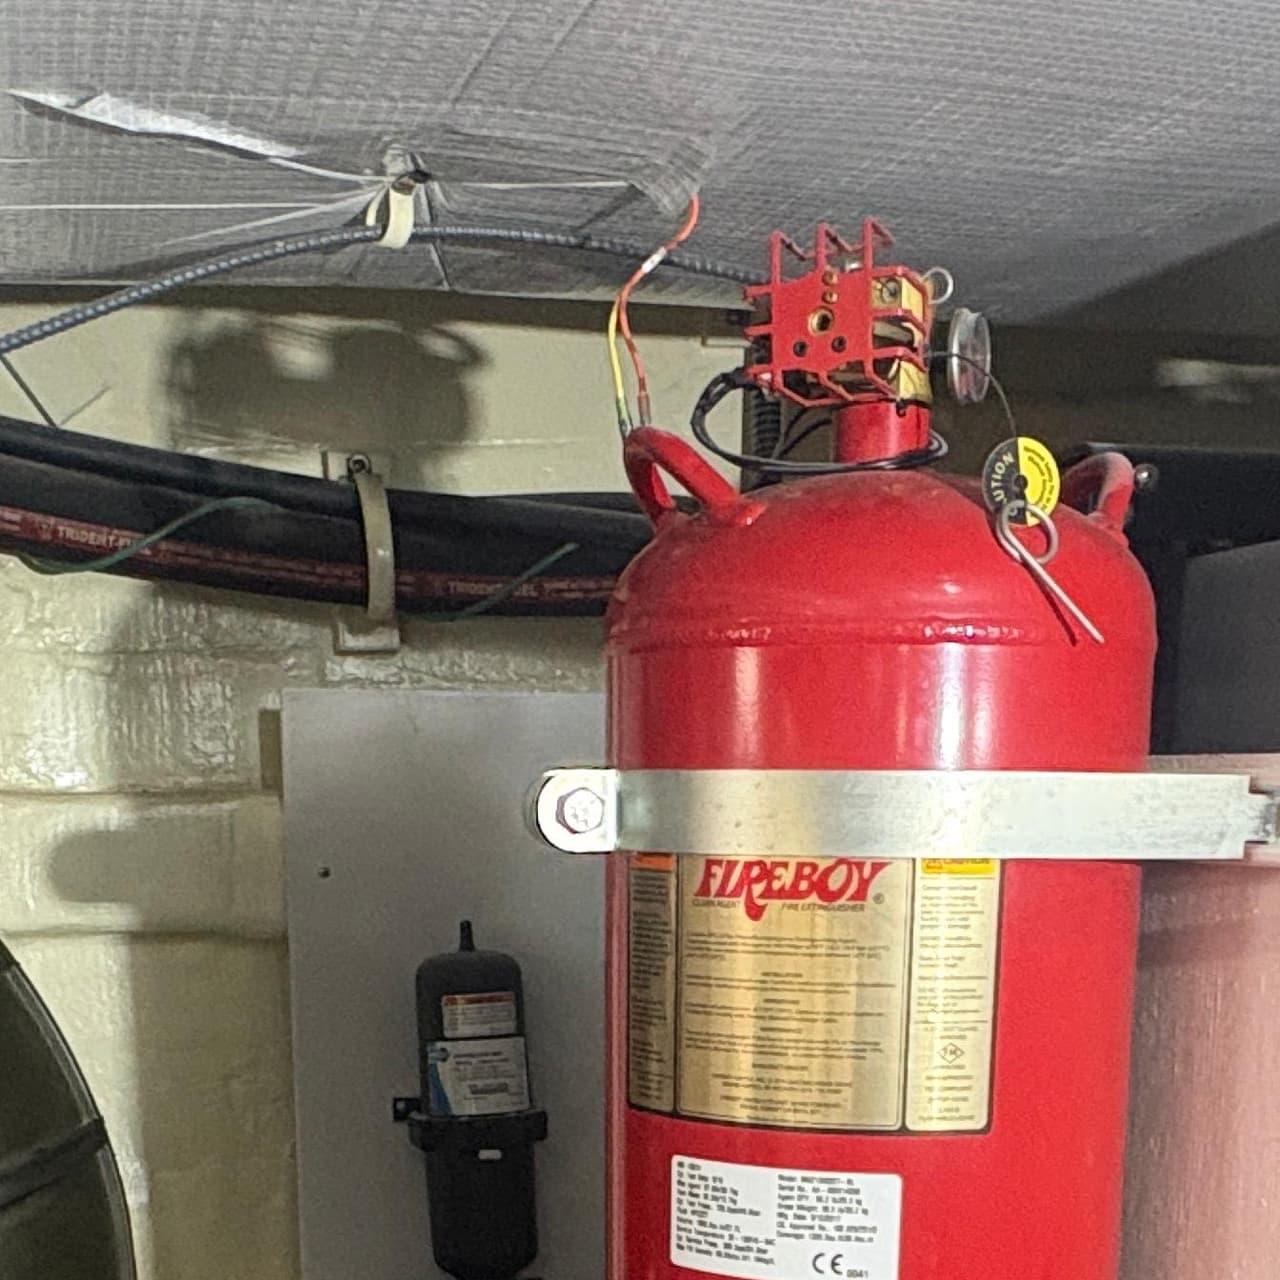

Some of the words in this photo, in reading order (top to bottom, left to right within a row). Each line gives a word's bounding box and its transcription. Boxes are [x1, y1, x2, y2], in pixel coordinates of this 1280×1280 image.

[991, 452, 1018, 516] CUTION
[693, 857, 894, 921] FIREBOY
[812, 1253, 843, 1275] CE
